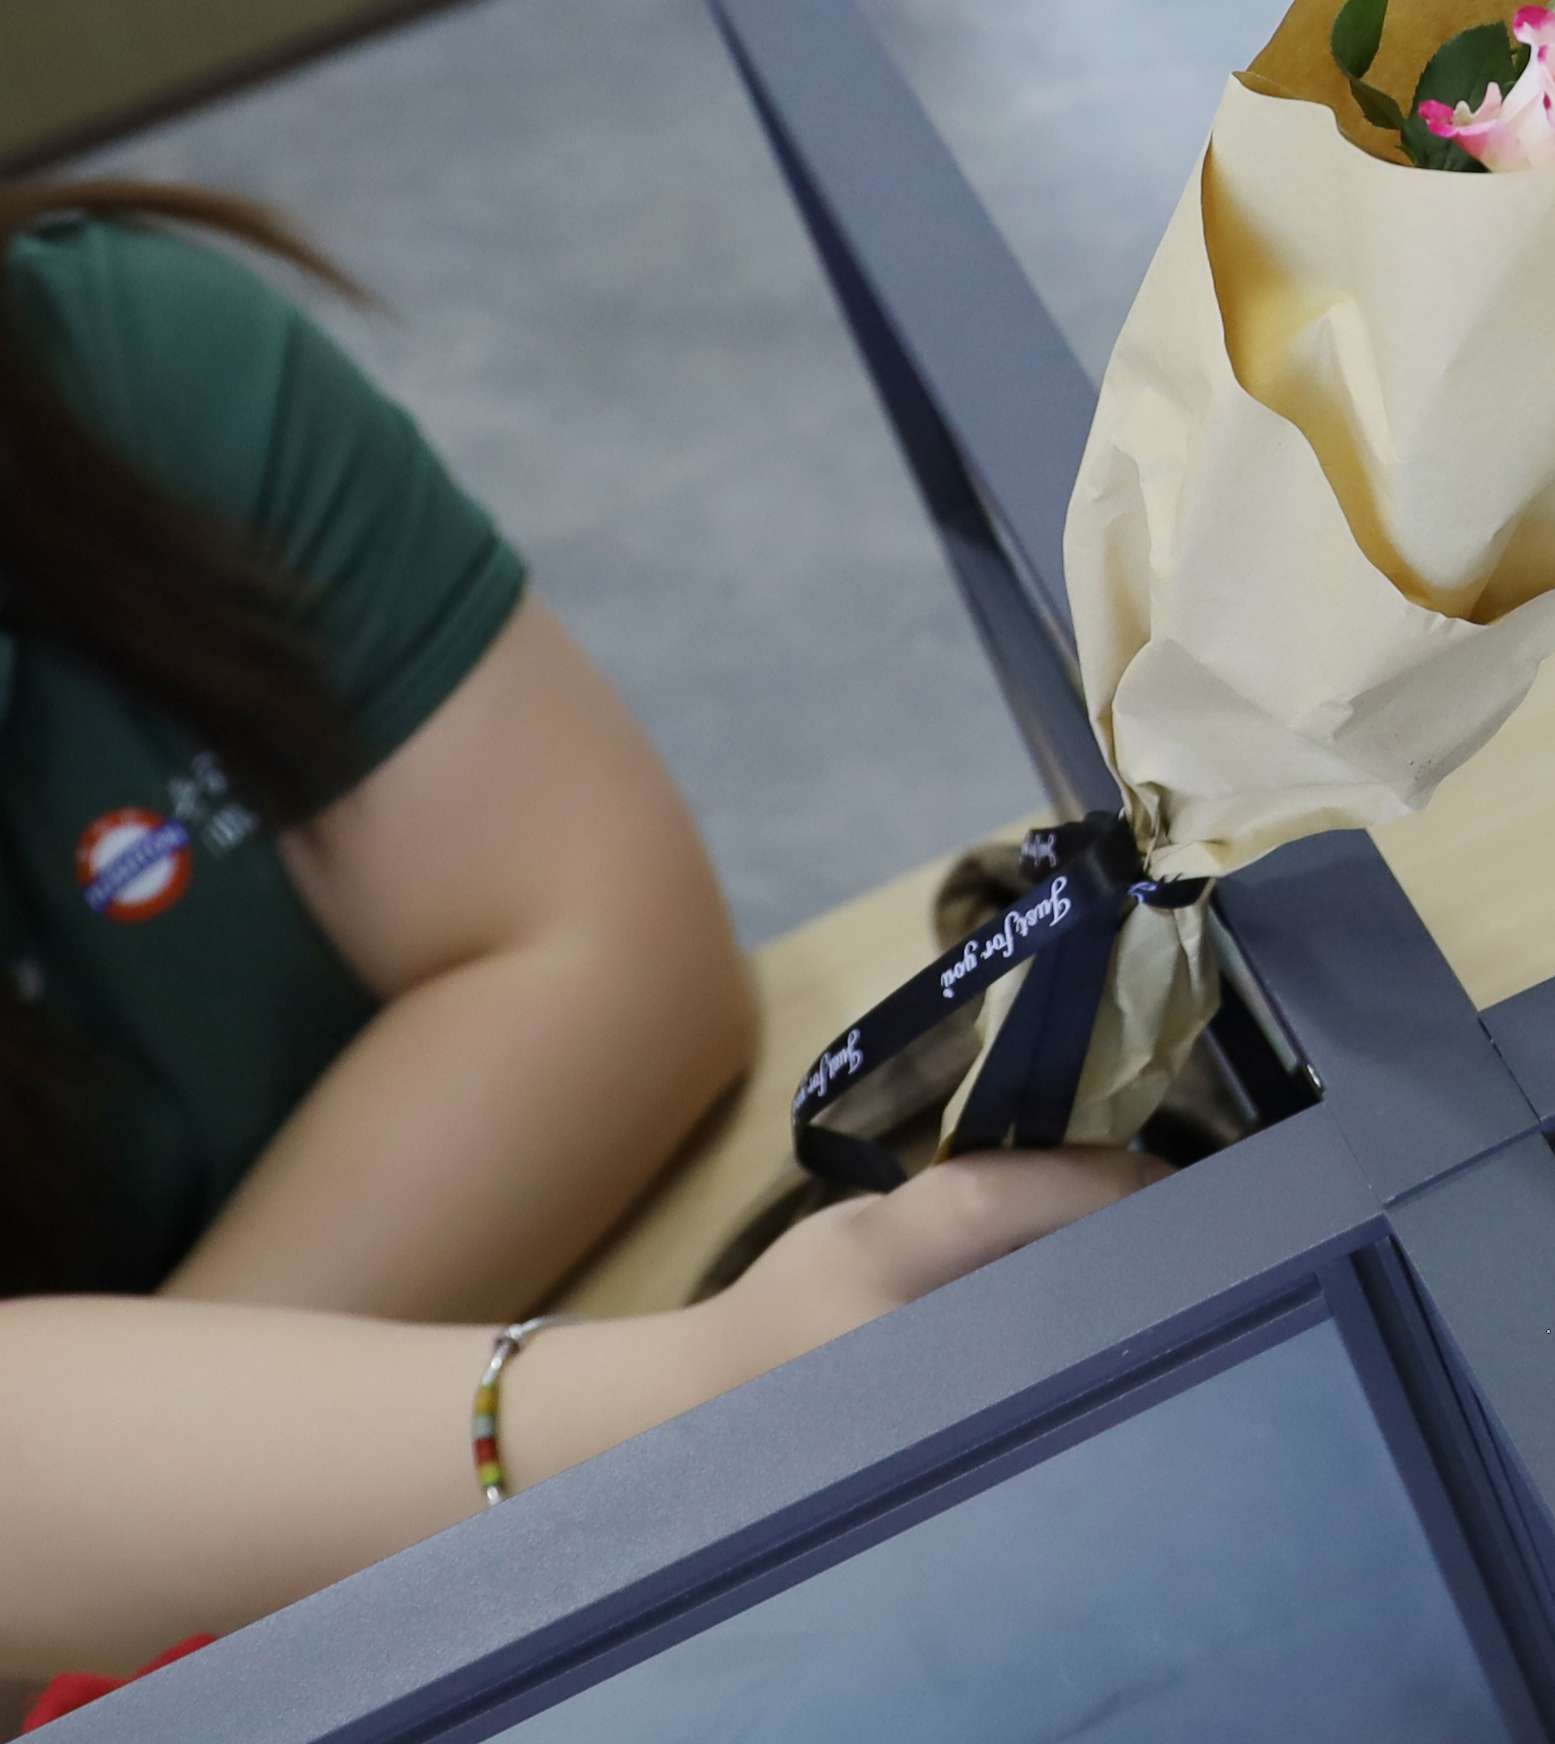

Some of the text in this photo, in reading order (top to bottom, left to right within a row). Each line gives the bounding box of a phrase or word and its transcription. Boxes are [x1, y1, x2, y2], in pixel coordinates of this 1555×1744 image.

[1015, 876, 1072, 937] Just
[980, 911, 1020, 960] for
[940, 940, 979, 989] you
